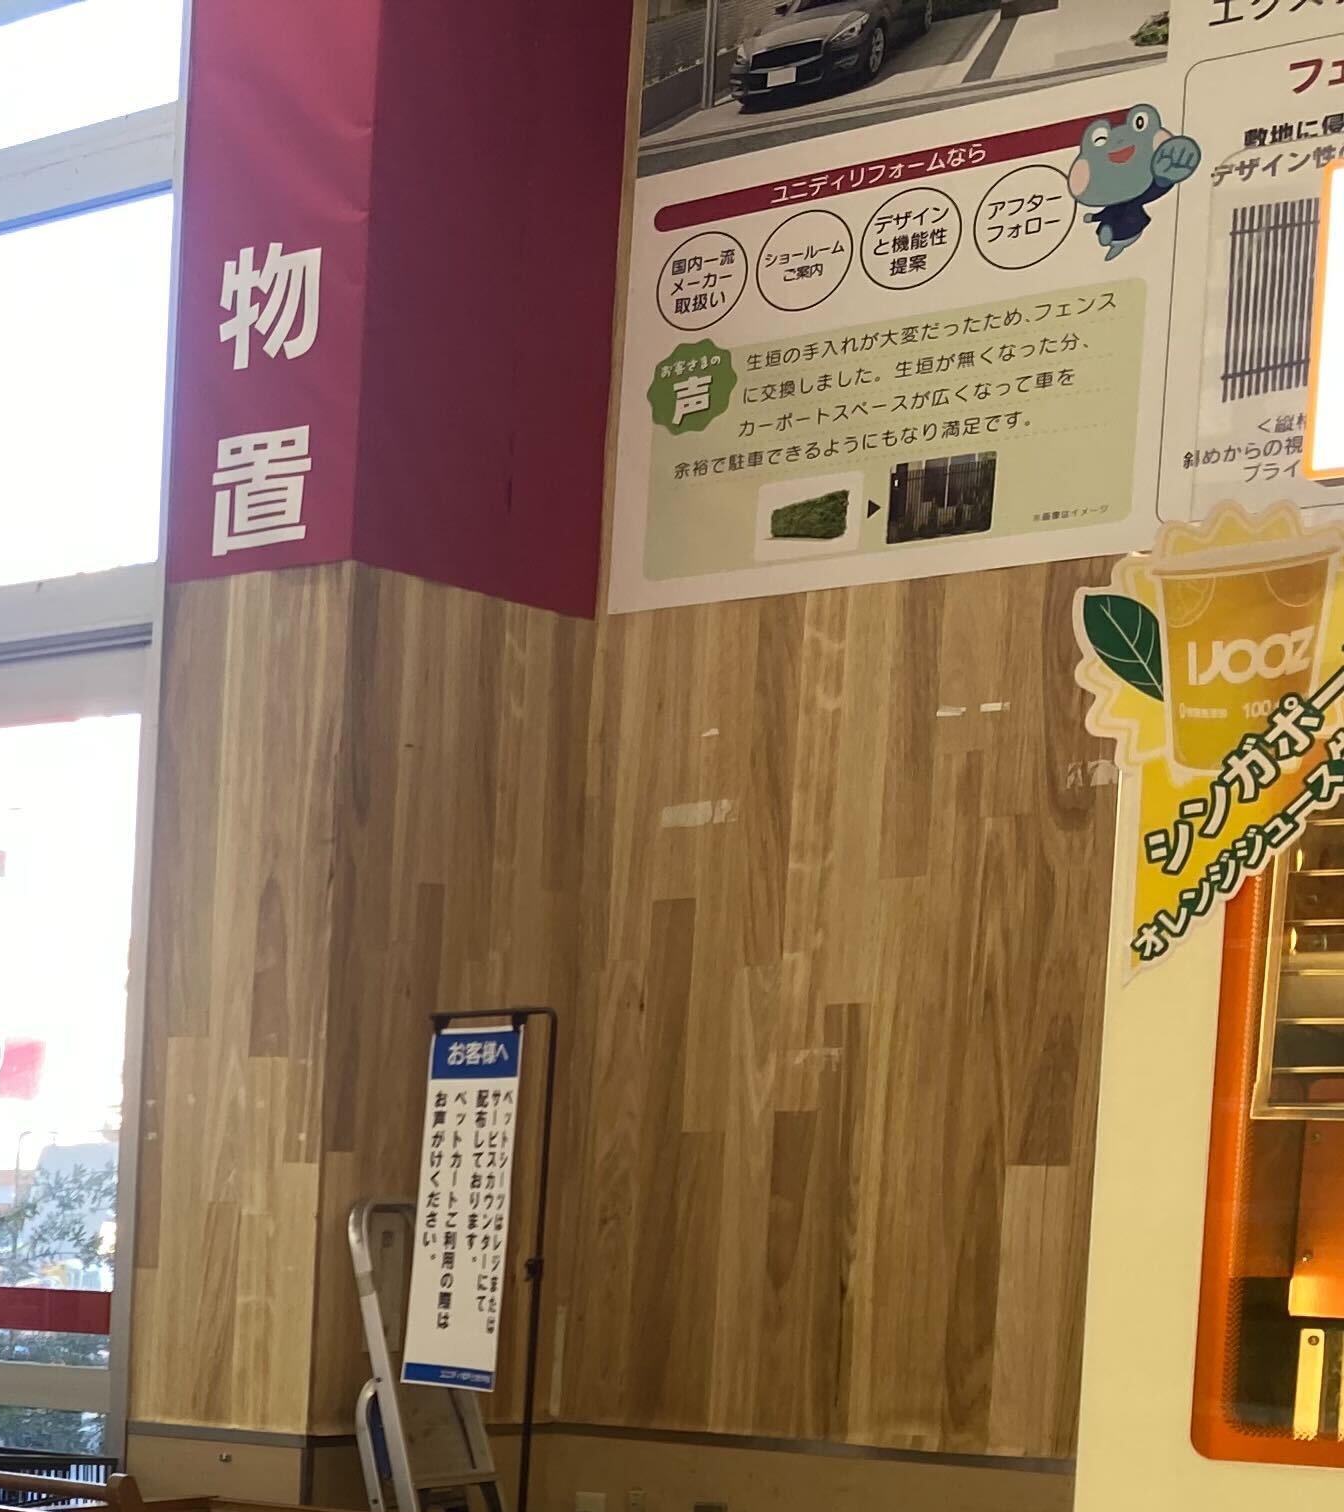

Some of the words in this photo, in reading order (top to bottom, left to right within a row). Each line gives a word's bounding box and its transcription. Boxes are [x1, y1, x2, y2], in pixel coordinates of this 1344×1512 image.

[769, 142, 987, 206] ユニディリフォームなら
[873, 204, 951, 233] デザイン
[986, 190, 1063, 221] アフター
[872, 227, 948, 258] と機能性
[985, 215, 1062, 244] フォロー
[670, 249, 736, 276] 国内一流
[764, 240, 845, 268] ショールーム
[889, 253, 928, 277] 提案
[670, 273, 733, 297] メーカー
[782, 263, 824, 282] ご案内
[674, 290, 726, 315] 取扱い
[746, 291, 1117, 373] 生垣の手入れが大変だったため、フェンス
[212, 241, 323, 557] 物置
[671, 375, 713, 426] 声
[737, 368, 1076, 439] カーポートスペースが広くなって車を
[673, 410, 1032, 480] 余裕で駐車できるようにもなり満足です。
[447, 1040, 511, 1067] お客様へ
